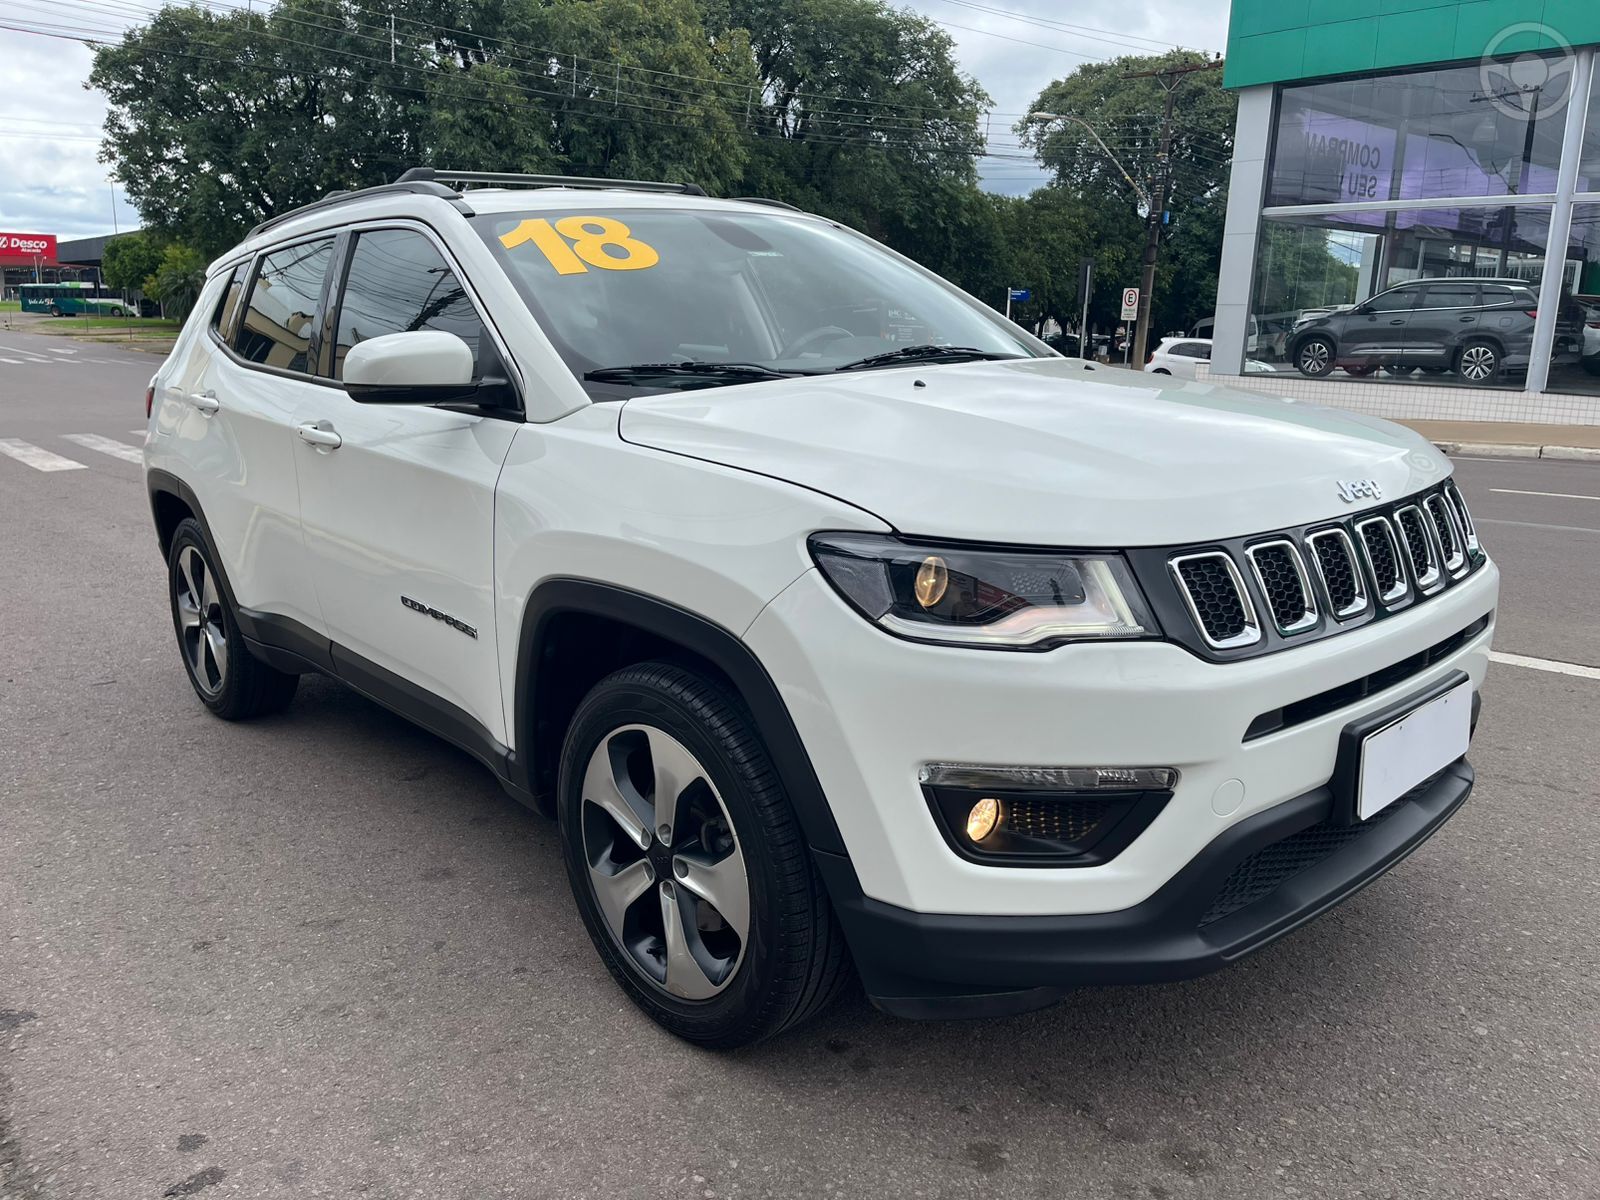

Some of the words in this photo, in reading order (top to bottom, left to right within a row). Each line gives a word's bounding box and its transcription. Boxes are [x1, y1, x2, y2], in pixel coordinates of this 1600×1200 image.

[10, 237, 48, 249] Desco
[498, 215, 660, 276] 18
[1128, 293, 1134, 303] E
[1336, 480, 1382, 504] Jeep
[400, 594, 478, 640] COMPASS
